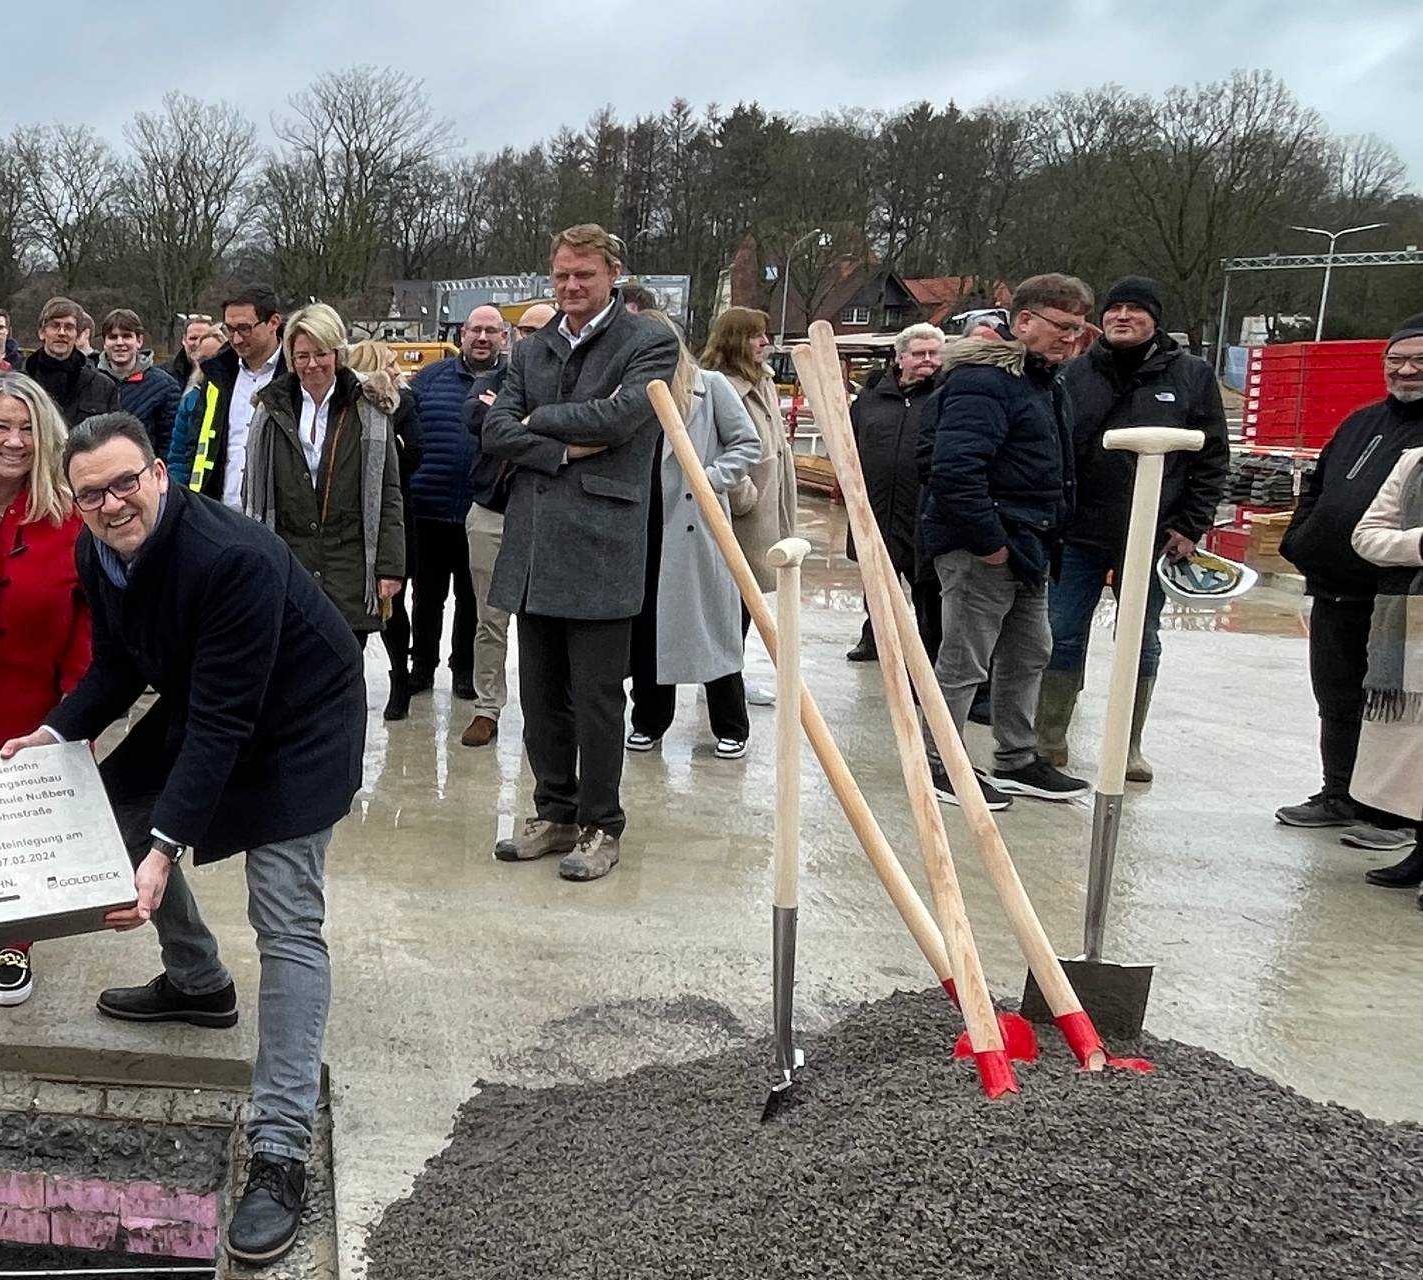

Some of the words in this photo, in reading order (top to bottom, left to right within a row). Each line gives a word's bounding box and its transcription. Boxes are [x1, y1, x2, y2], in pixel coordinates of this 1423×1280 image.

[403, 351, 420, 362] CAT
[26, 788, 75, 802] Nußberg
[66, 831, 83, 841] am
[59, 871, 121, 887] GOLDBECK
